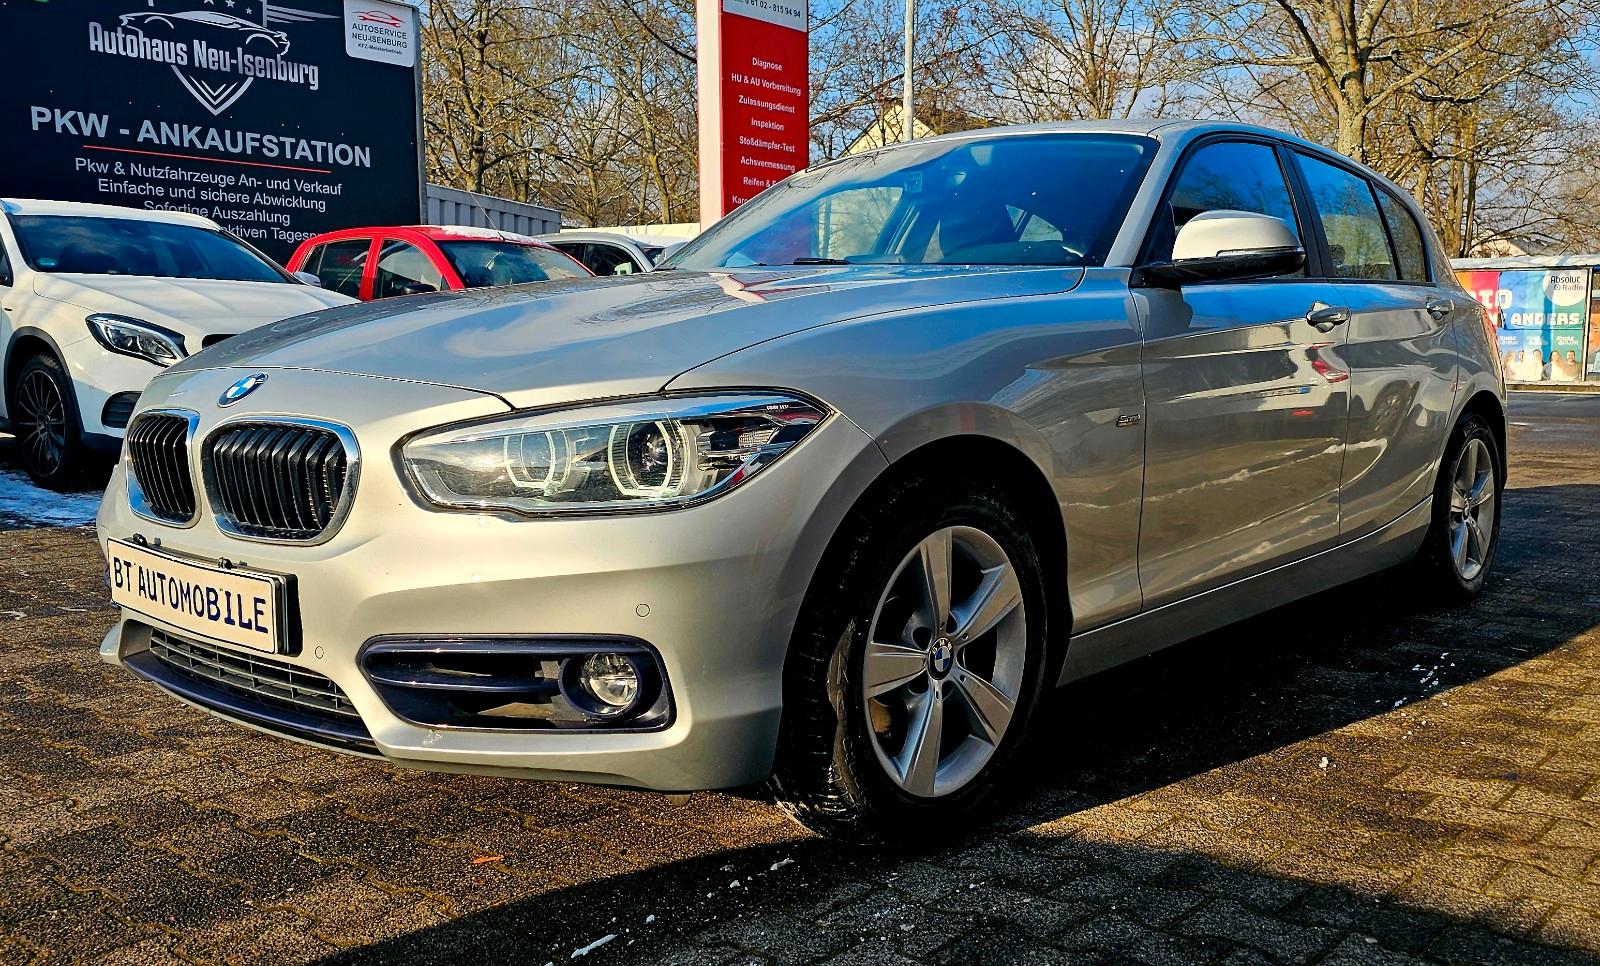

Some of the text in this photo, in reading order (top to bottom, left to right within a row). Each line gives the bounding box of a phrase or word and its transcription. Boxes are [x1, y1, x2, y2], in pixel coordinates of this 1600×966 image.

[760, 1, 768, 9] 02
[773, 4, 783, 13] 815
[785, 7, 792, 16] 94
[794, 10, 801, 18] 94
[352, 23, 407, 39] AUTOSERVICE
[352, 33, 407, 49] NEU-ISENBURG
[89, 22, 319, 91] Autohaus Neu-Isenburg
[752, 57, 783, 71] Diagnose
[731, 73, 801, 97] HU & AU Vorbereitung
[738, 95, 795, 114] Zulassungsdienst
[751, 117, 784, 131] Inspektion
[30, 106, 109, 138] PKW
[137, 120, 370, 168] ANKAUFSTATION
[740, 156, 796, 173] Achsvermessung
[75, 157, 342, 195] Pkw & Nutzfahrzeuge An- und Verkauf
[743, 177, 765, 186] Reifen
[98, 178, 327, 212] Einfache und sichere Abwicklung
[212, 206, 290, 226] Auszahlung
[113, 557, 269, 634] BT AUTOMOBILE
